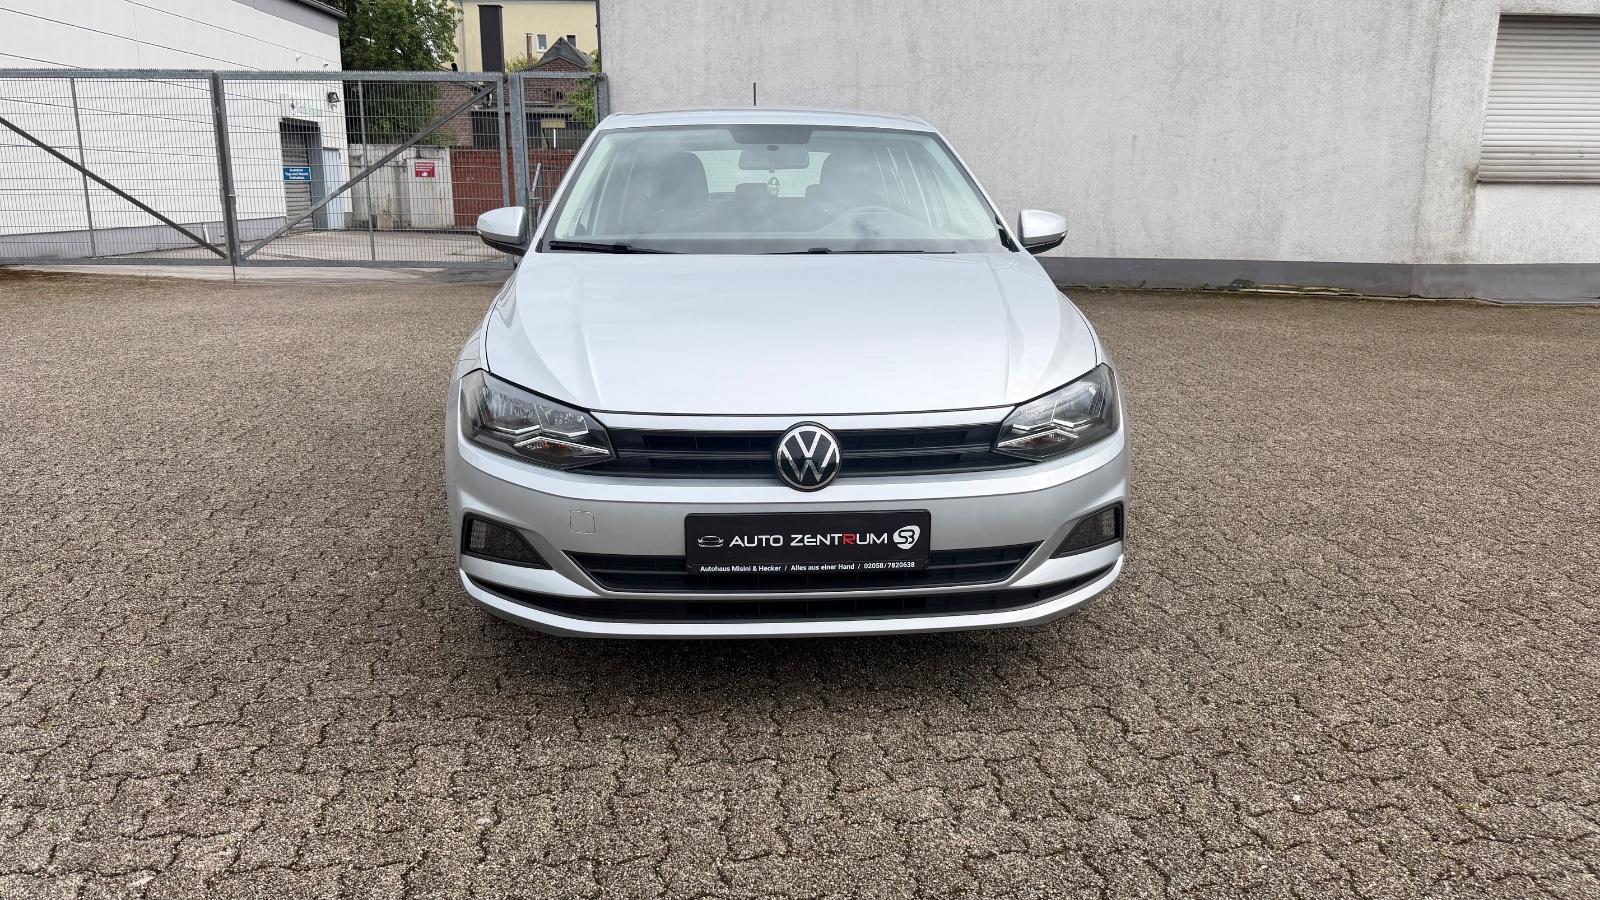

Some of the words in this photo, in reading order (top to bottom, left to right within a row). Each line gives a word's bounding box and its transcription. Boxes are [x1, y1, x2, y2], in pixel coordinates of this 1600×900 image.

[729, 535, 783, 547] AUTO
[790, 533, 888, 546] ZENTRUM
[758, 564, 782, 572] Hecker
